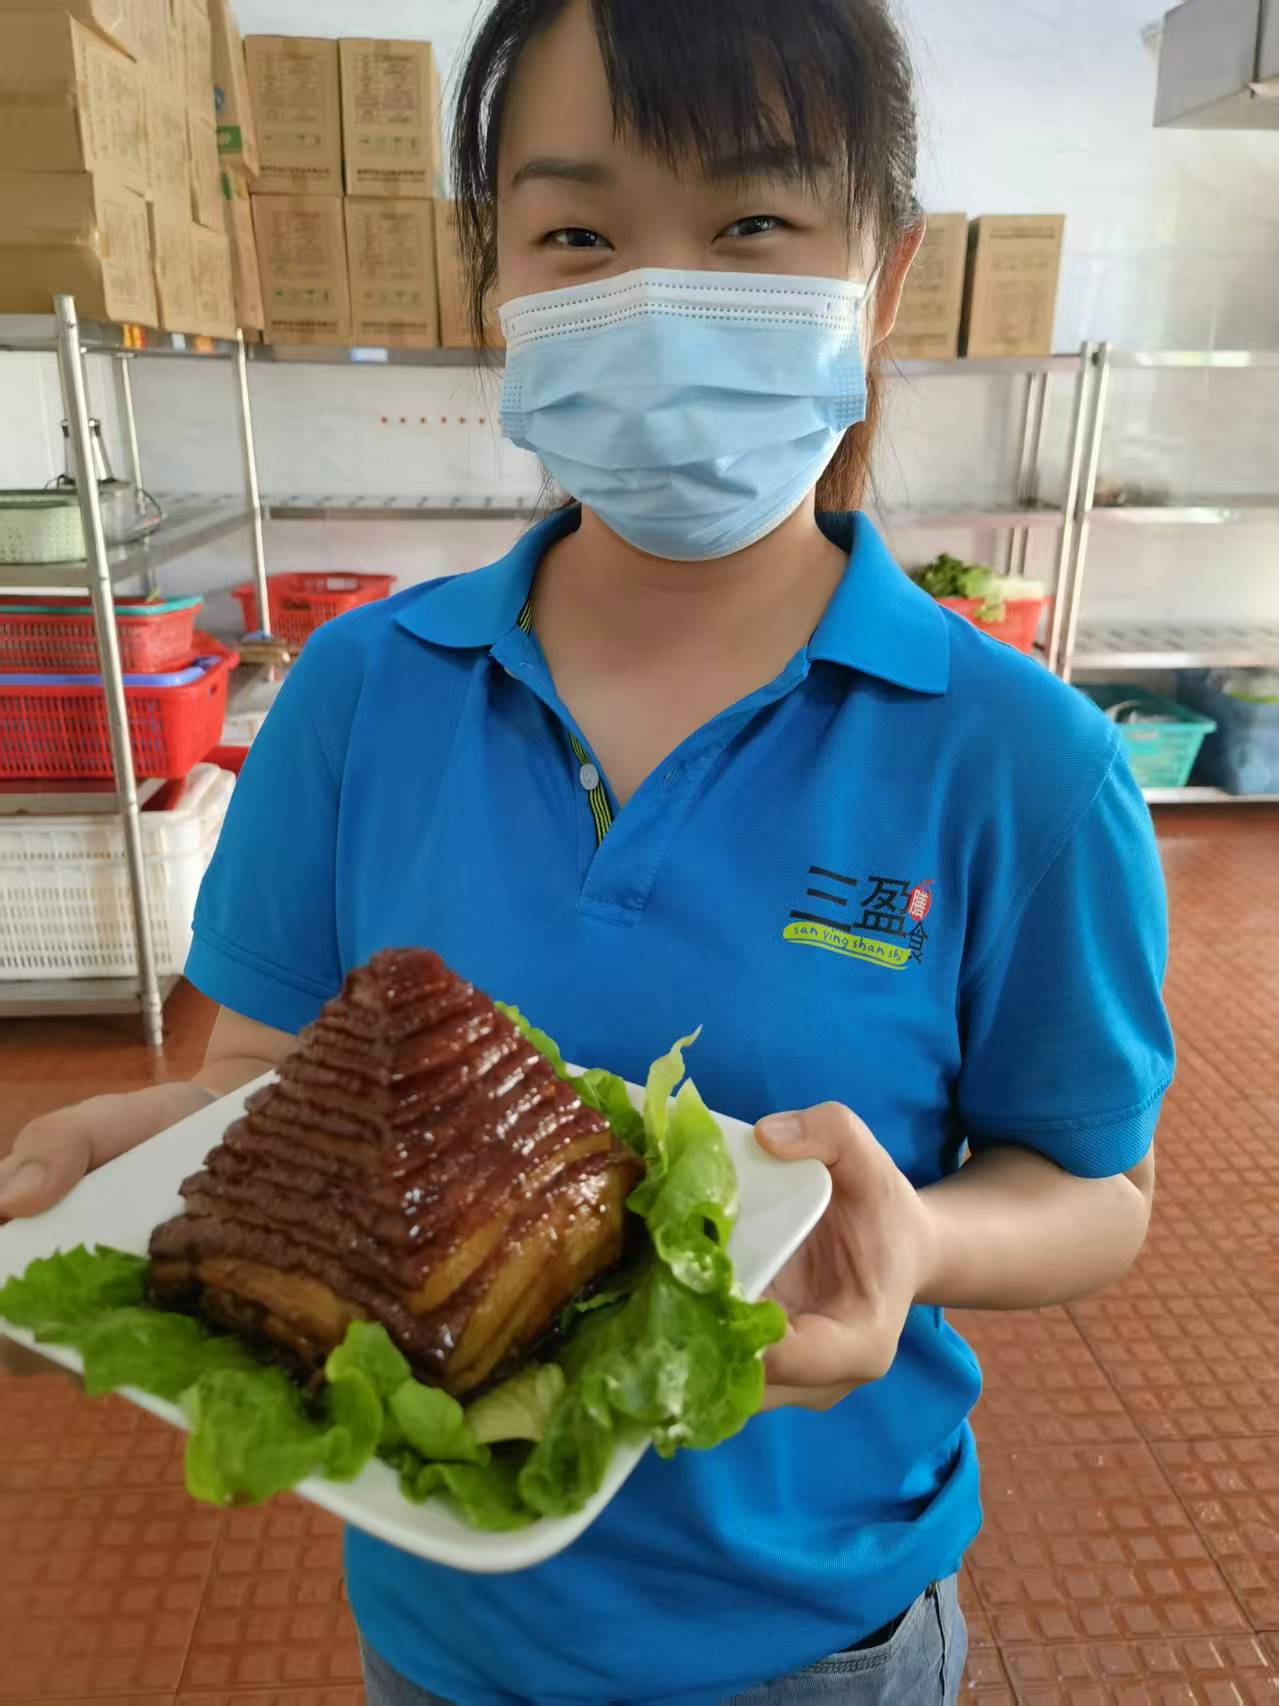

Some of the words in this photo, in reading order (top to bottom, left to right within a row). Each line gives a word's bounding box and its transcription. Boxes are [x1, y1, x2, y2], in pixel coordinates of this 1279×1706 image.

[789, 865, 911, 937] 三盈
[793, 926, 818, 936] san
[823, 930, 849, 949] ying
[852, 938, 885, 955] shan
